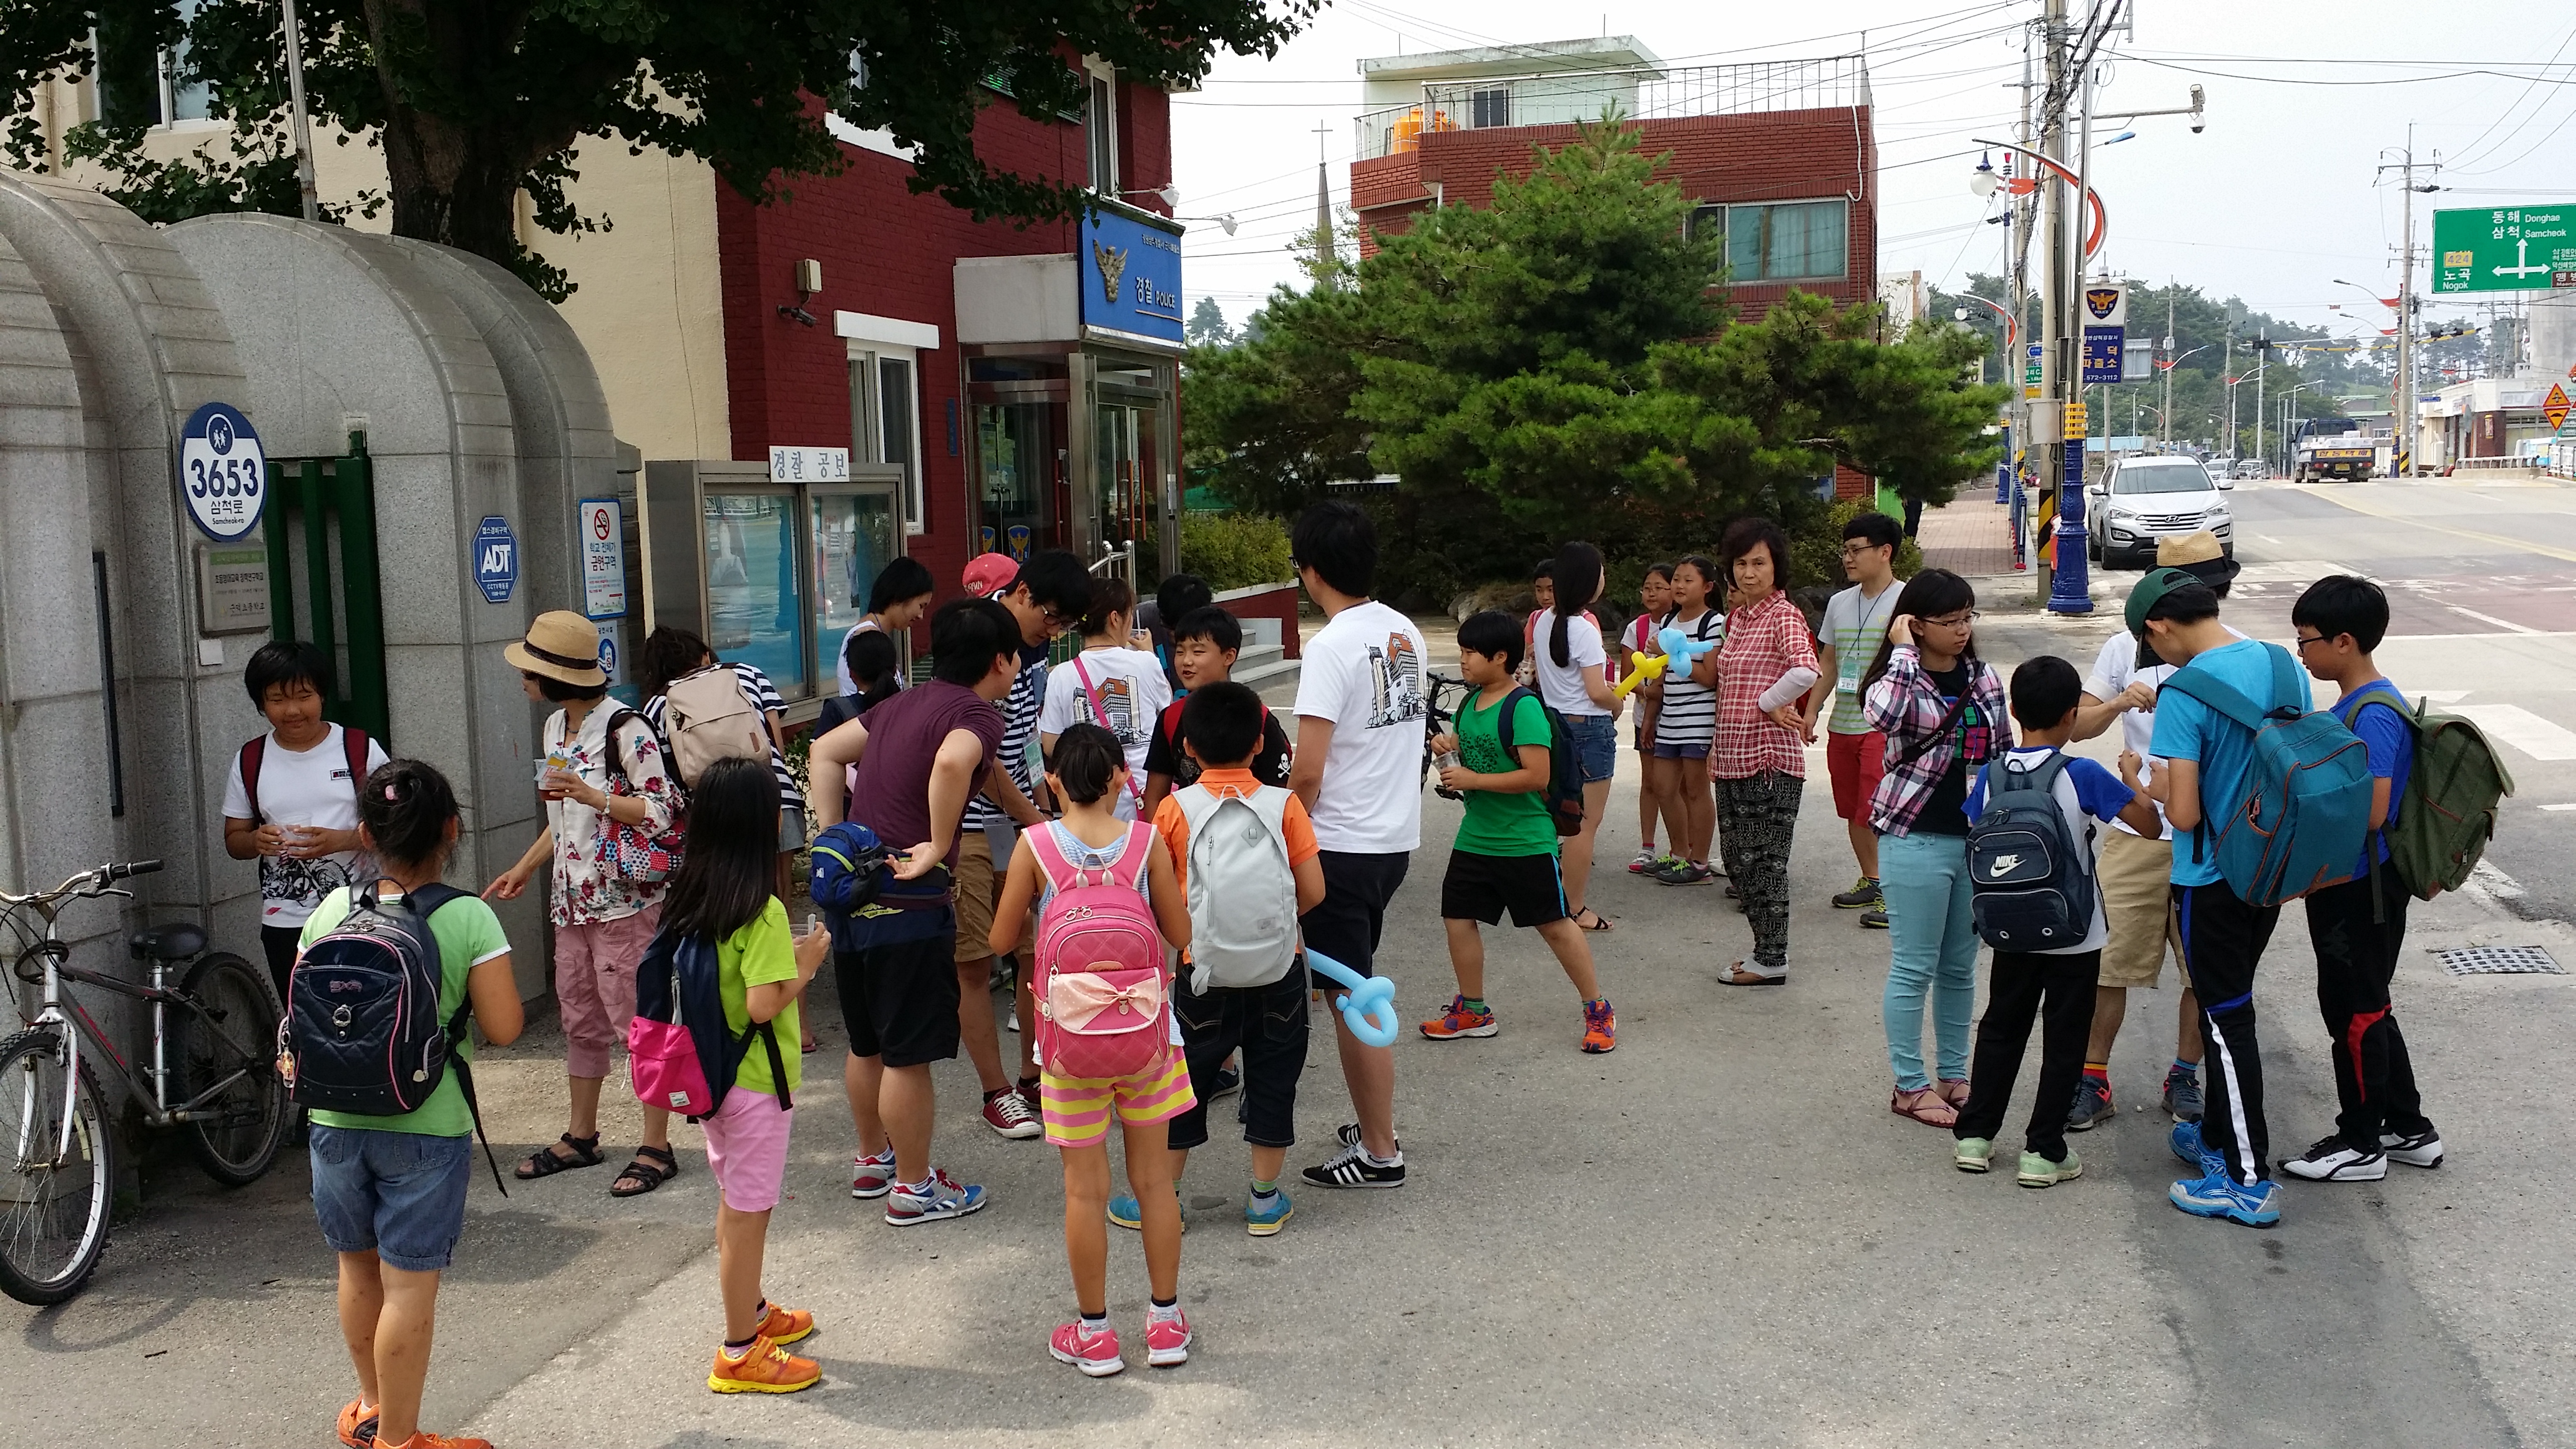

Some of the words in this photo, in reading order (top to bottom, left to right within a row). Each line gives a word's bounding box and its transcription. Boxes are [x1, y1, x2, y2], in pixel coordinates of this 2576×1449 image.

[2492, 210, 2520, 224] 동해
[2525, 213, 2560, 224] Donghae
[2492, 225, 2520, 240] 삼척
[2525, 229, 2567, 238] Samcheok
[2447, 255, 2469, 263] 424
[2443, 268, 2471, 281] 노곡
[1136, 276, 1153, 304] 경찰
[1156, 291, 1175, 309] POLICE
[2442, 281, 2469, 291] Nogok
[774, 450, 803, 479] 경찰
[818, 452, 846, 478] 공보
[191, 458, 259, 499] 3653
[211, 500, 243, 515] 삼척로
[482, 544, 511, 573] ADT
[1920, 729, 1944, 749] Canon
[1994, 854, 2019, 867] NIKE
